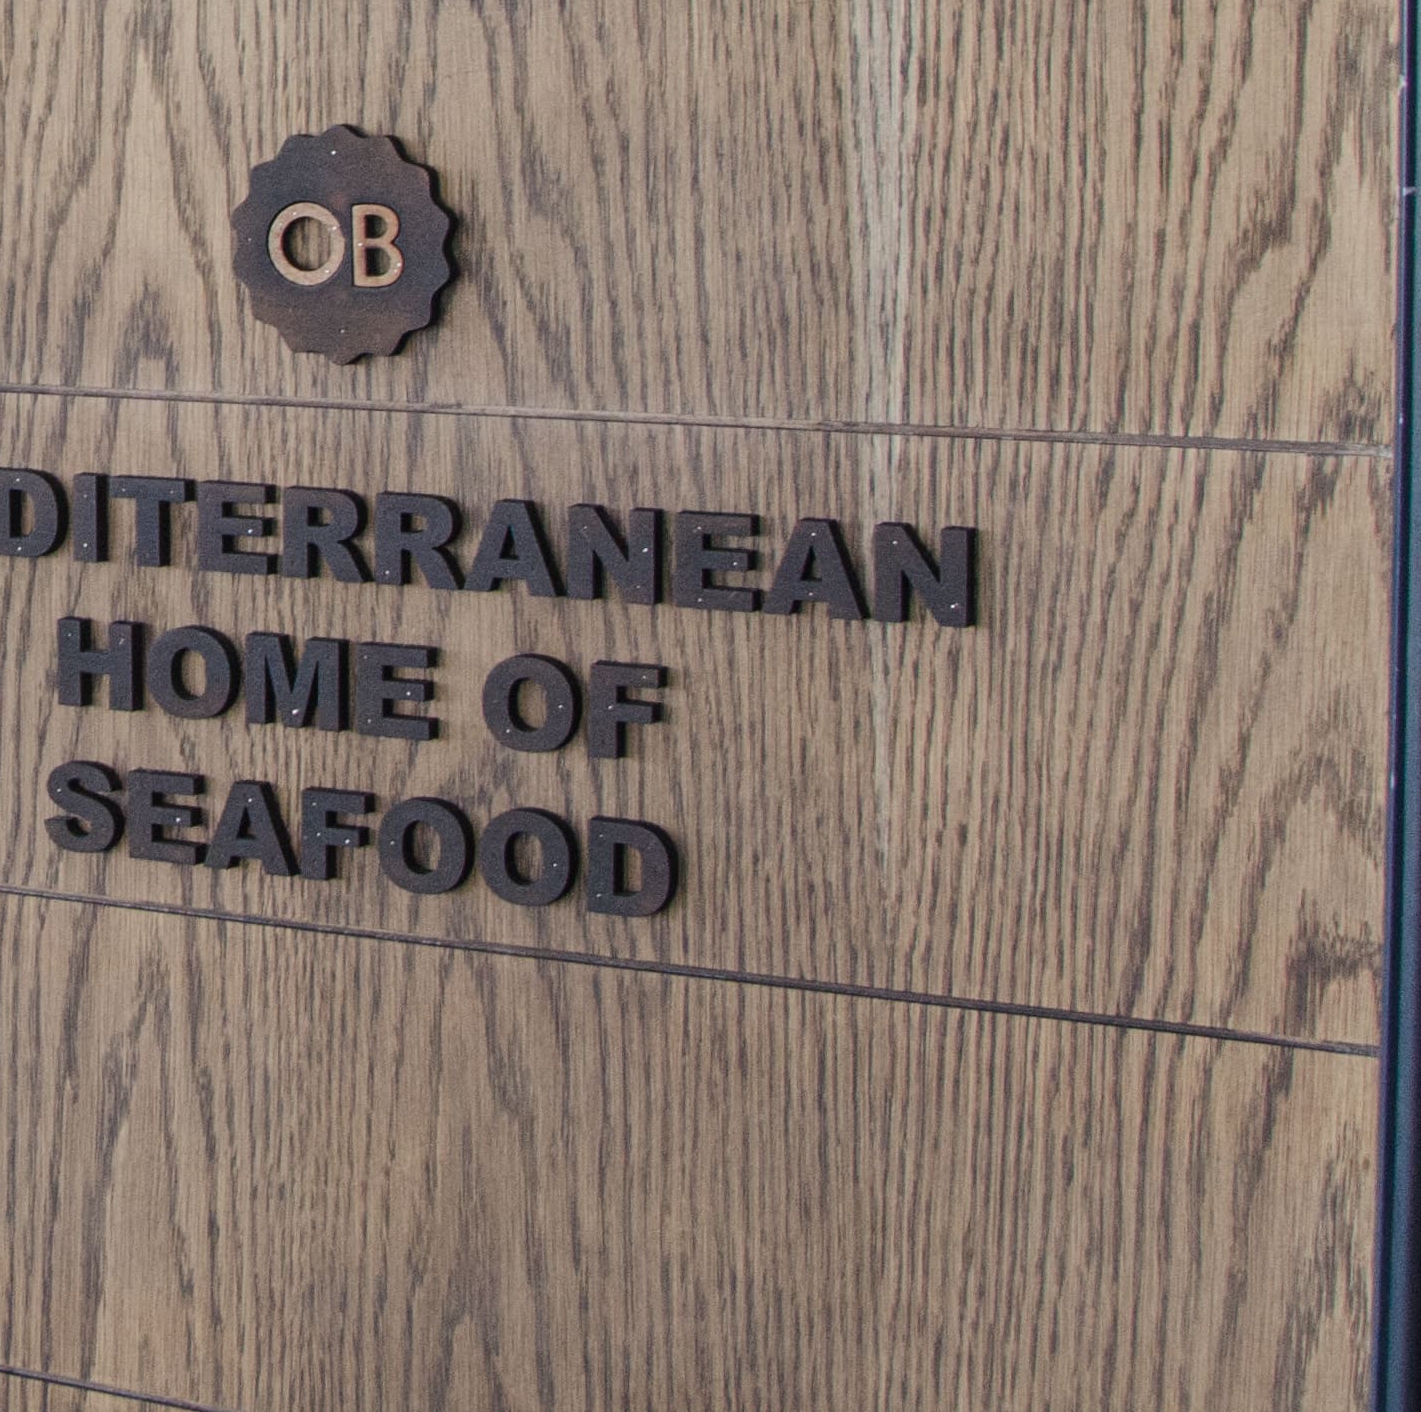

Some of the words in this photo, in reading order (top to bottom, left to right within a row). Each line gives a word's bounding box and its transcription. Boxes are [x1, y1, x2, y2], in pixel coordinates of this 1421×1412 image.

[267, 201, 405, 288] OB
[57, 615, 441, 742] HOME
[481, 652, 669, 760] OF
[43, 759, 681, 918] SEAFOOD
